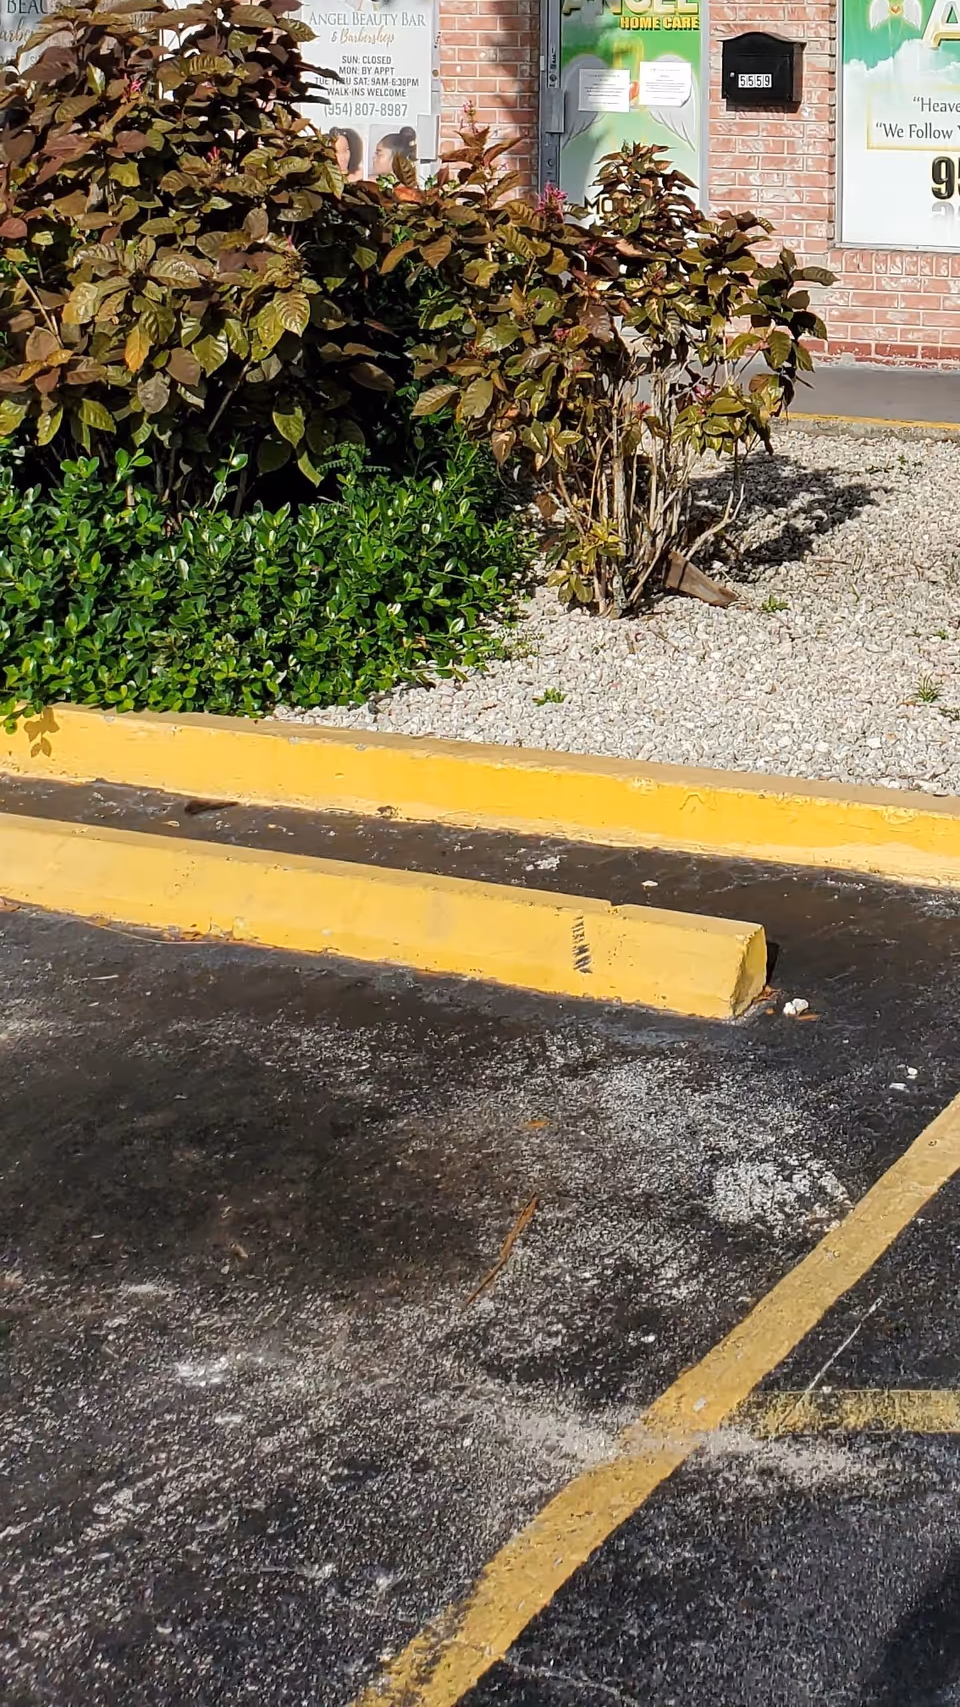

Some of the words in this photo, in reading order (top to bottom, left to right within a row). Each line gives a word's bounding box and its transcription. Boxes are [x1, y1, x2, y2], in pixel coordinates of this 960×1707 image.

[309, 11, 349, 26] ANGEL
[352, 11, 399, 26] BEAUTY
[401, 12, 427, 27] BAR
[619, 16, 661, 30] HOME
[662, 16, 700, 31] CARE
[340, 25, 395, 48] Barbershop
[342, 55, 360, 64] SUN:
[362, 56, 391, 65] CLOSED
[339, 66, 360, 75] MON:
[361, 67, 372, 75] BY
[374, 67, 395, 76] APPT
[353, 77, 370, 86] SAT:
[740, 75, 770, 87] 5559
[327, 87, 365, 96] WALK-INS
[367, 88, 407, 97] WELCOME
[908, 122, 953, 141] Follow
